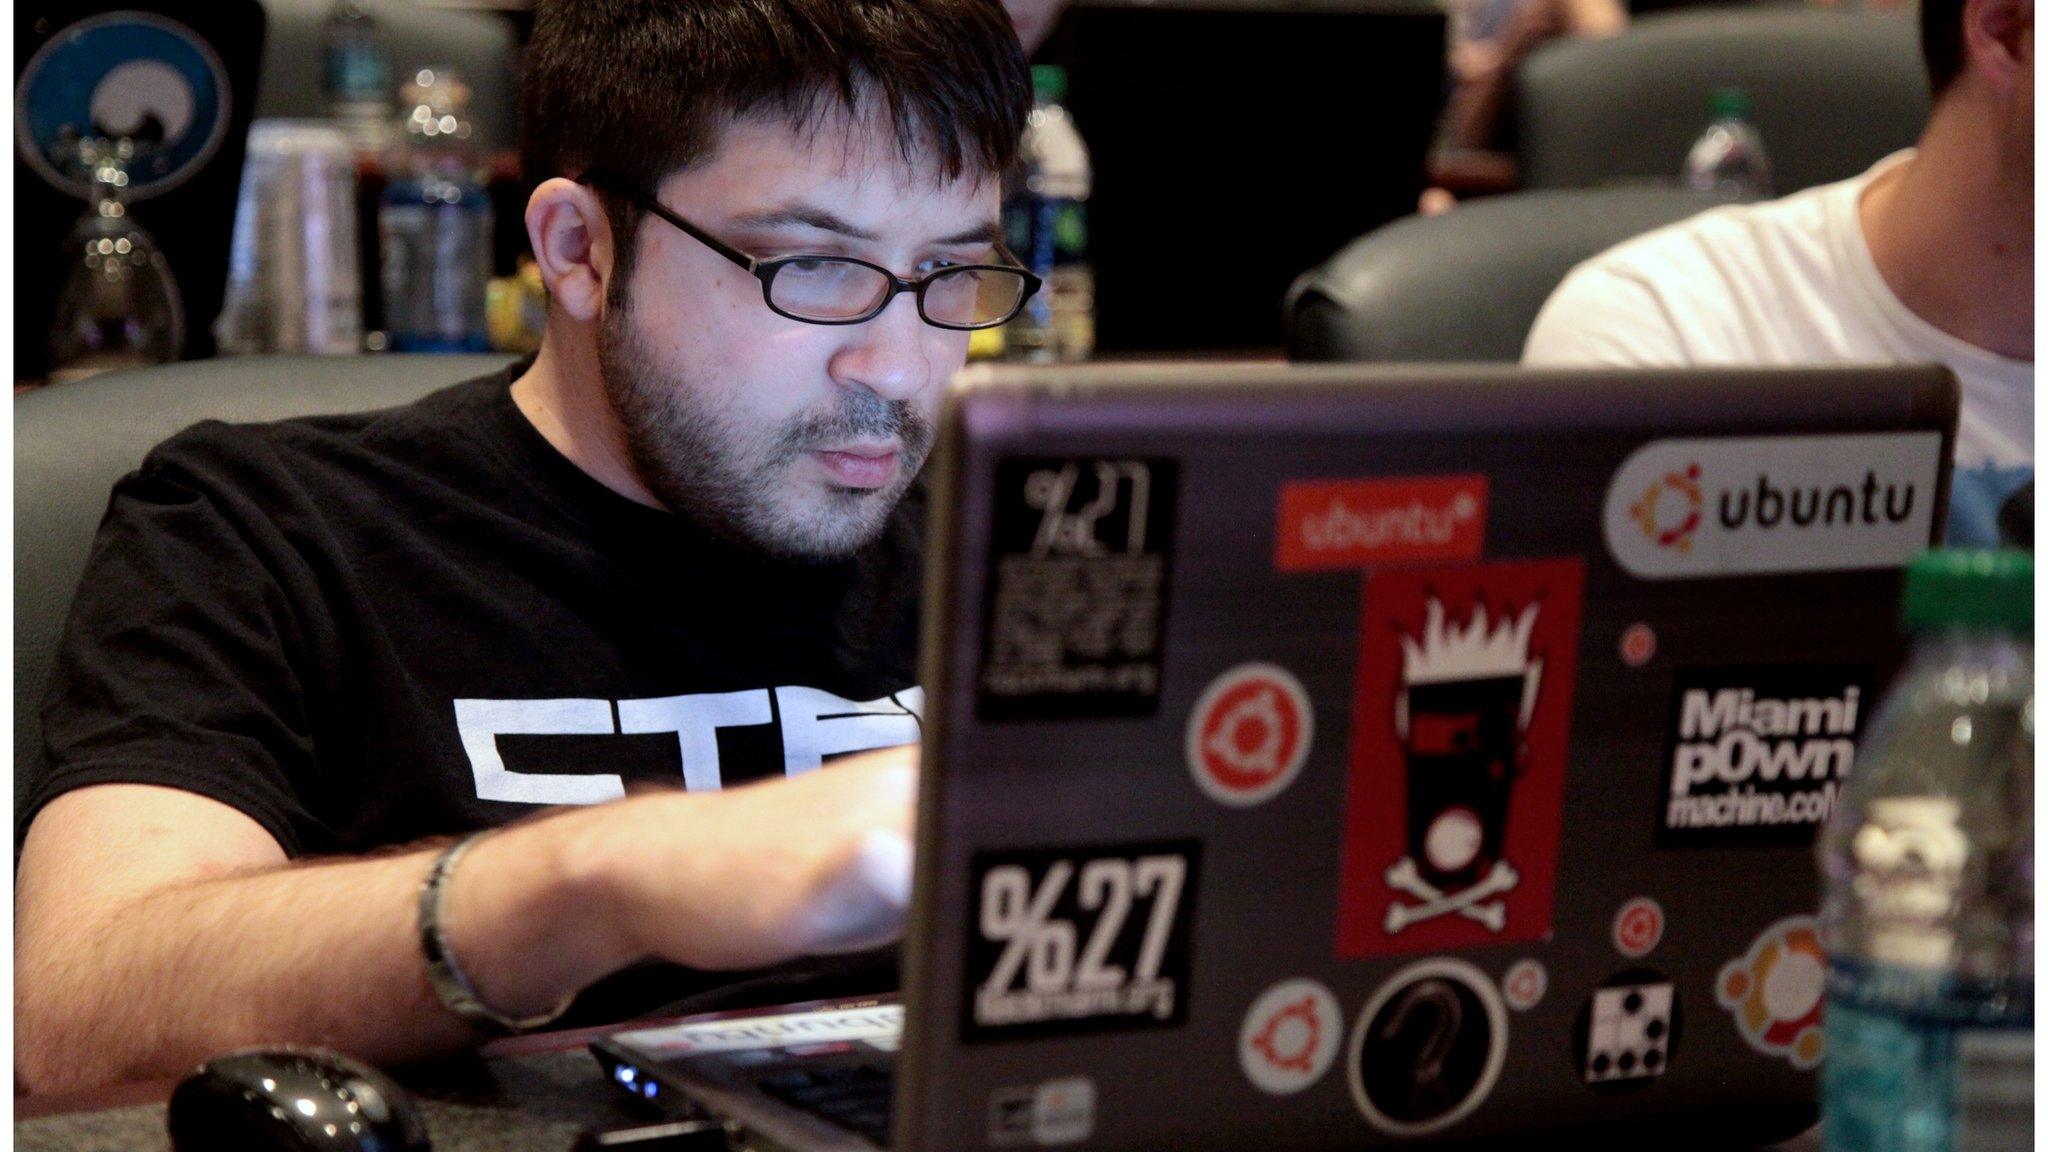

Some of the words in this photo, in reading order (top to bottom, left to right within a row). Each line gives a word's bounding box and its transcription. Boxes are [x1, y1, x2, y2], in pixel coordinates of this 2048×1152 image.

[1302, 498, 1454, 551] ubuntu
[1718, 470, 1915, 530] ubuntu
[1681, 684, 1861, 740] Miami
[978, 853, 1188, 994] %27
